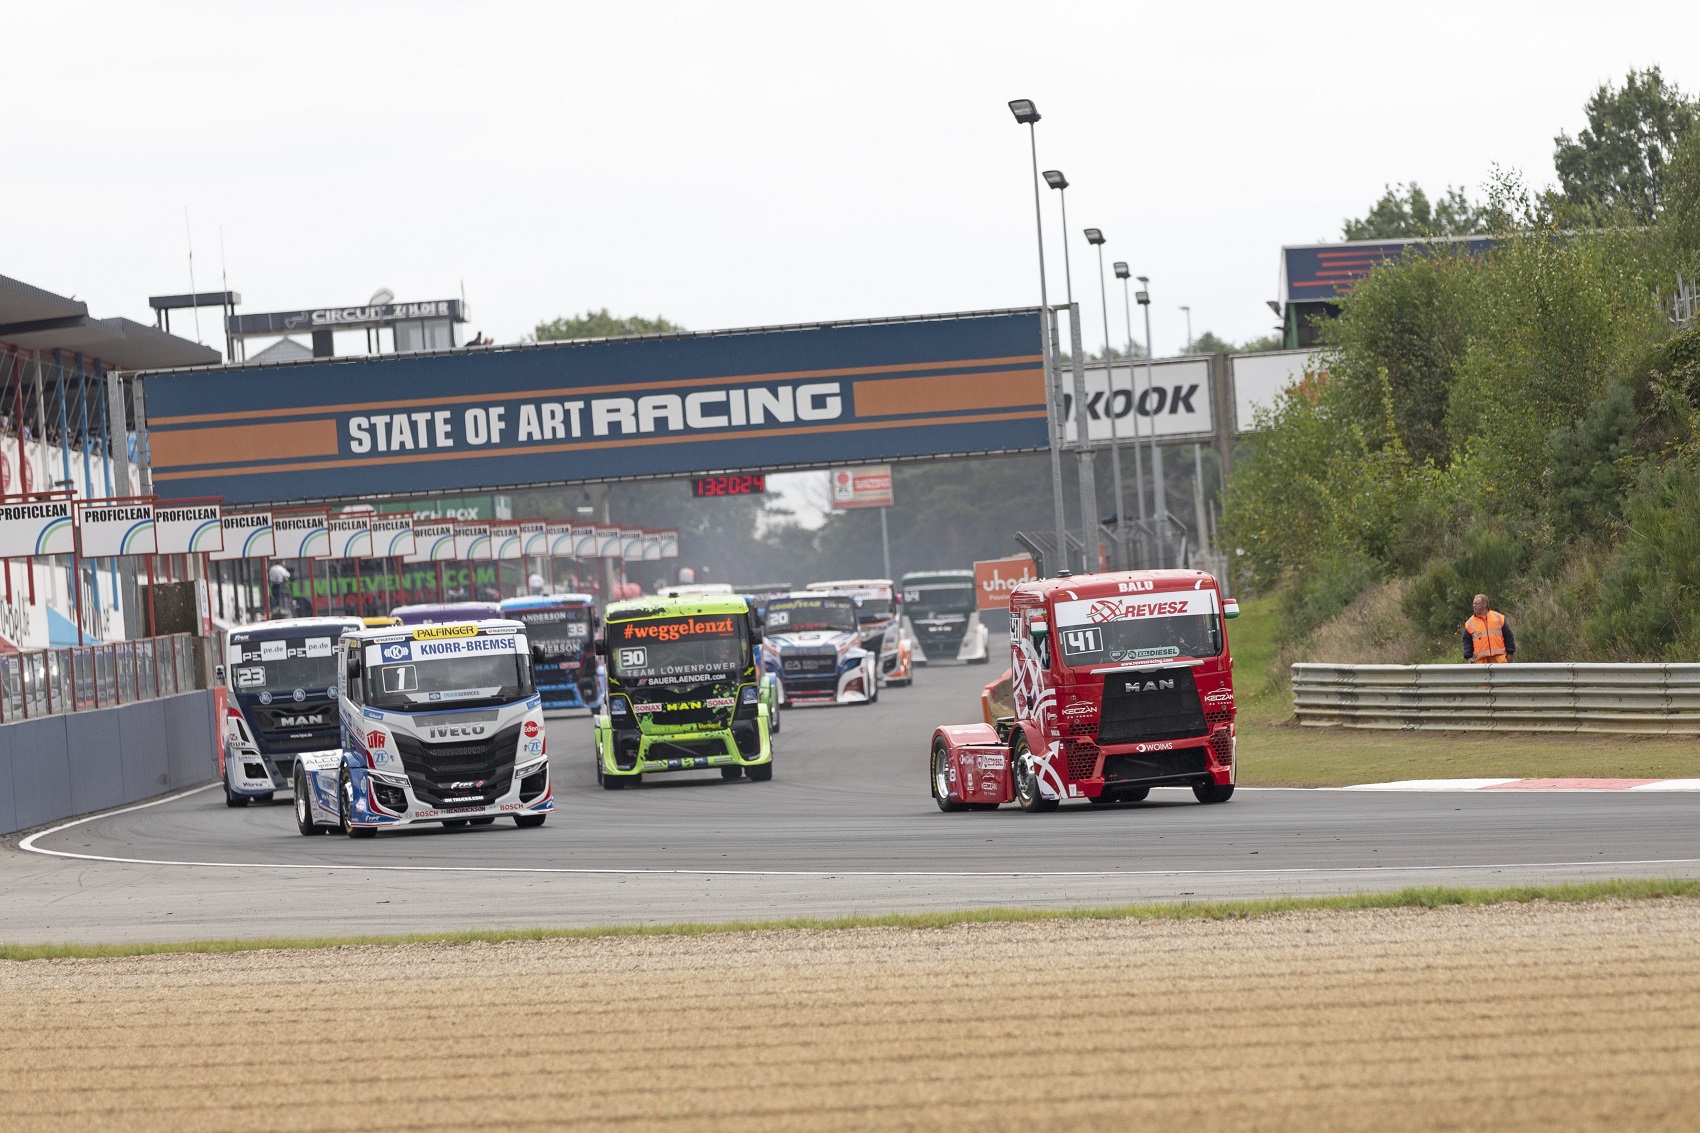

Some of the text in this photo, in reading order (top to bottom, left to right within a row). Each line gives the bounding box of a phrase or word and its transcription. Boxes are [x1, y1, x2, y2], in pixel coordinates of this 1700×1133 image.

[349, 382, 842, 453] STATE OF ART RACING
[0, 503, 67, 521] PROFICLEAN
[85, 507, 150, 523] PROFICLEAN
[156, 508, 217, 522] PROFICLEAN
[222, 515, 268, 529] OFICLEAN
[1118, 581, 1154, 592] BALU
[521, 612, 566, 622] ANDERSON
[769, 613, 789, 625] 20
[416, 626, 475, 638] PALFINGER
[568, 623, 587, 636] 33
[624, 617, 734, 641] #weggelenzt
[308, 642, 329, 650] pe.de
[420, 638, 515, 655] KNORR-BREMSE
[1068, 630, 1095, 651] 41
[263, 646, 284, 654] pe.de
[1150, 648, 1177, 656] DIESEL
[622, 650, 645, 666] 30
[627, 662, 736, 677] TEAM LÖWENPOWER
[240, 668, 264, 686] 23
[396, 667, 405, 690] 1
[1125, 678, 1174, 692] MAN
[634, 704, 662, 712] SONAX
[667, 701, 702, 711] MAN
[707, 698, 735, 706] SONAX
[281, 714, 322, 726] MAN
[430, 723, 485, 738] IVECO
[366, 730, 386, 748] UTA
[1145, 742, 1173, 751] WOIMS
[446, 806, 486, 814] HENDRICKSON
[500, 803, 524, 811] BOSCH
